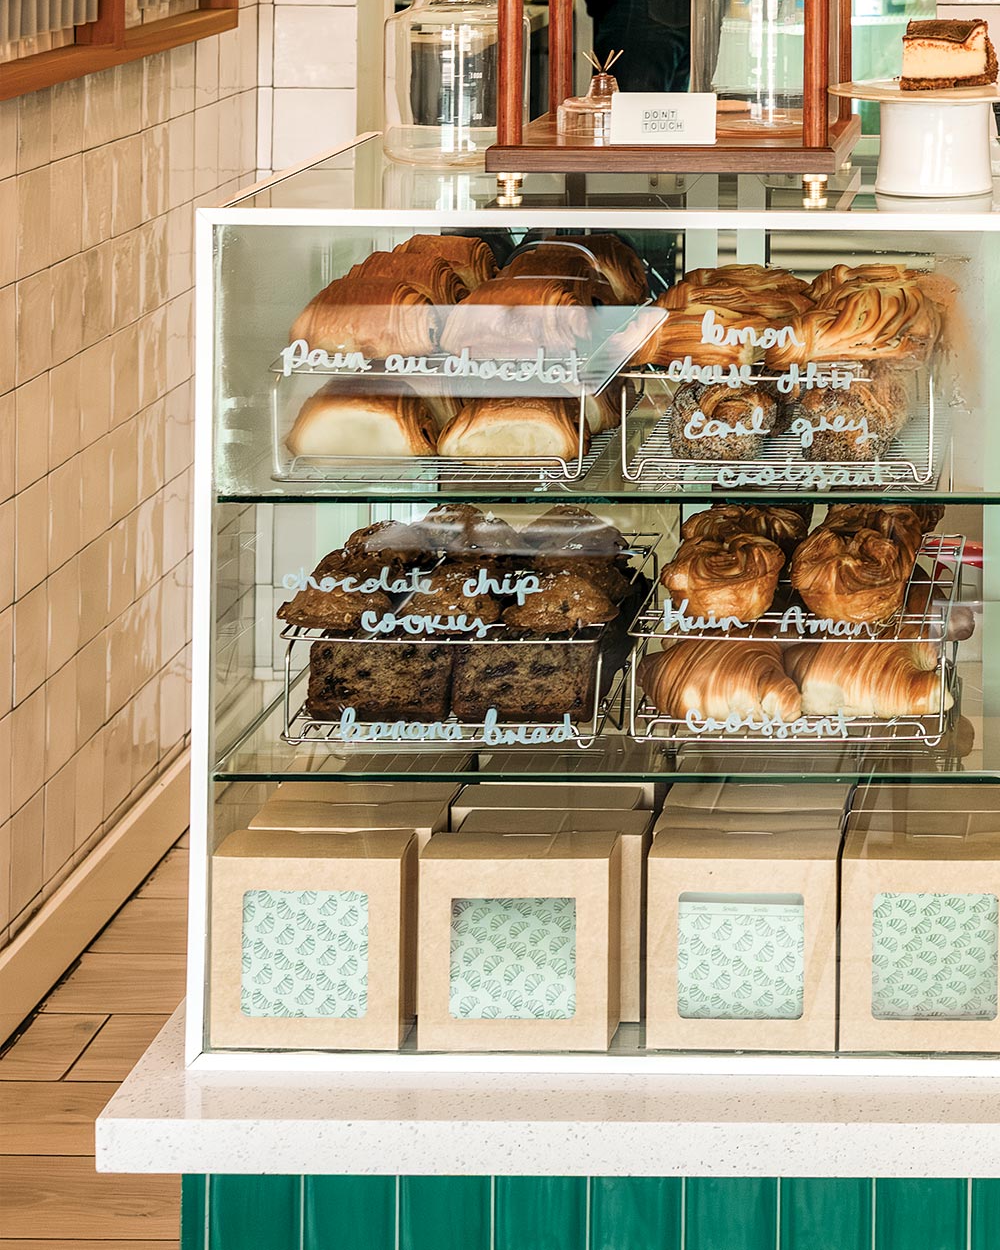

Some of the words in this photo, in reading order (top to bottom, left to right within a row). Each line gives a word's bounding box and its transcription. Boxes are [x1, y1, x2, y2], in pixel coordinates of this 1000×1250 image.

[643, 110, 677, 120] DONT
[643, 121, 683, 131] TOUCH
[701, 310, 806, 349] lemon
[384, 353, 439, 374] au
[443, 348, 582, 385] chocolat
[684, 407, 770, 440] Earl
[791, 415, 879, 449] grey
[282, 567, 440, 595] chocolate
[462, 568, 544, 606] chip
[338, 707, 463, 743] banana
[482, 707, 574, 746] bread
